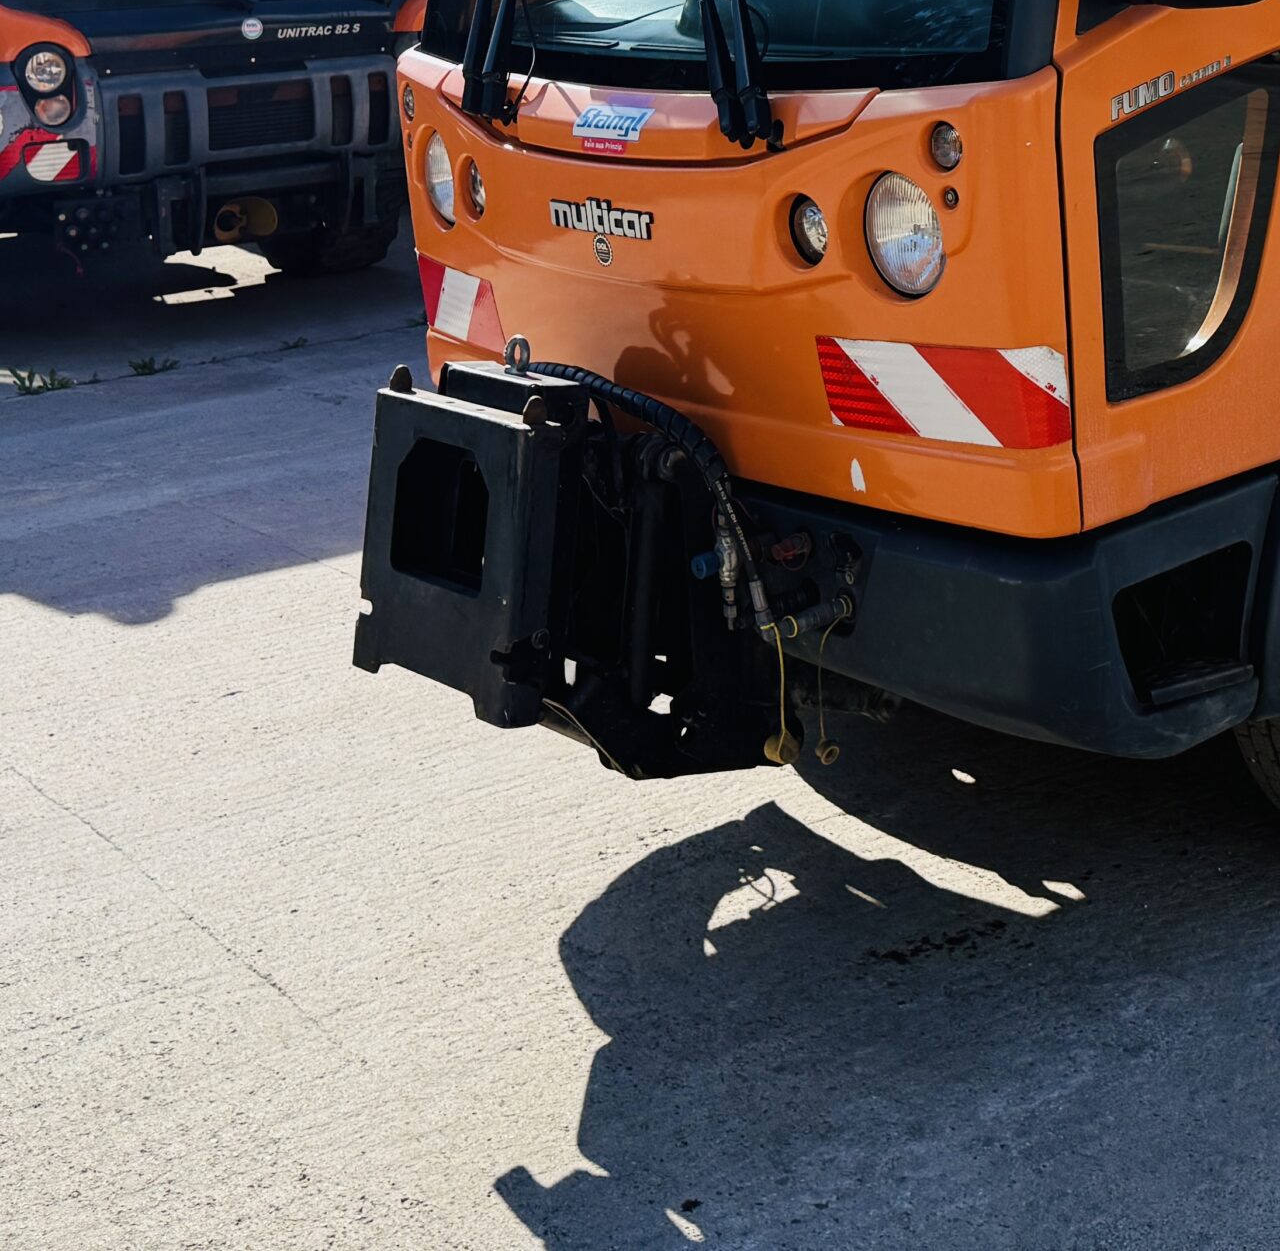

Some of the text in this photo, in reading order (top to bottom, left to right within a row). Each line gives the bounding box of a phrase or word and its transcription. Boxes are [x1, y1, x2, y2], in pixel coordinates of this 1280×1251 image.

[277, 23, 361, 39] UNITRAC 82 S
[1111, 70, 1176, 122] FUMO
[577, 108, 649, 137] Stangl
[549, 197, 654, 240] multicar
